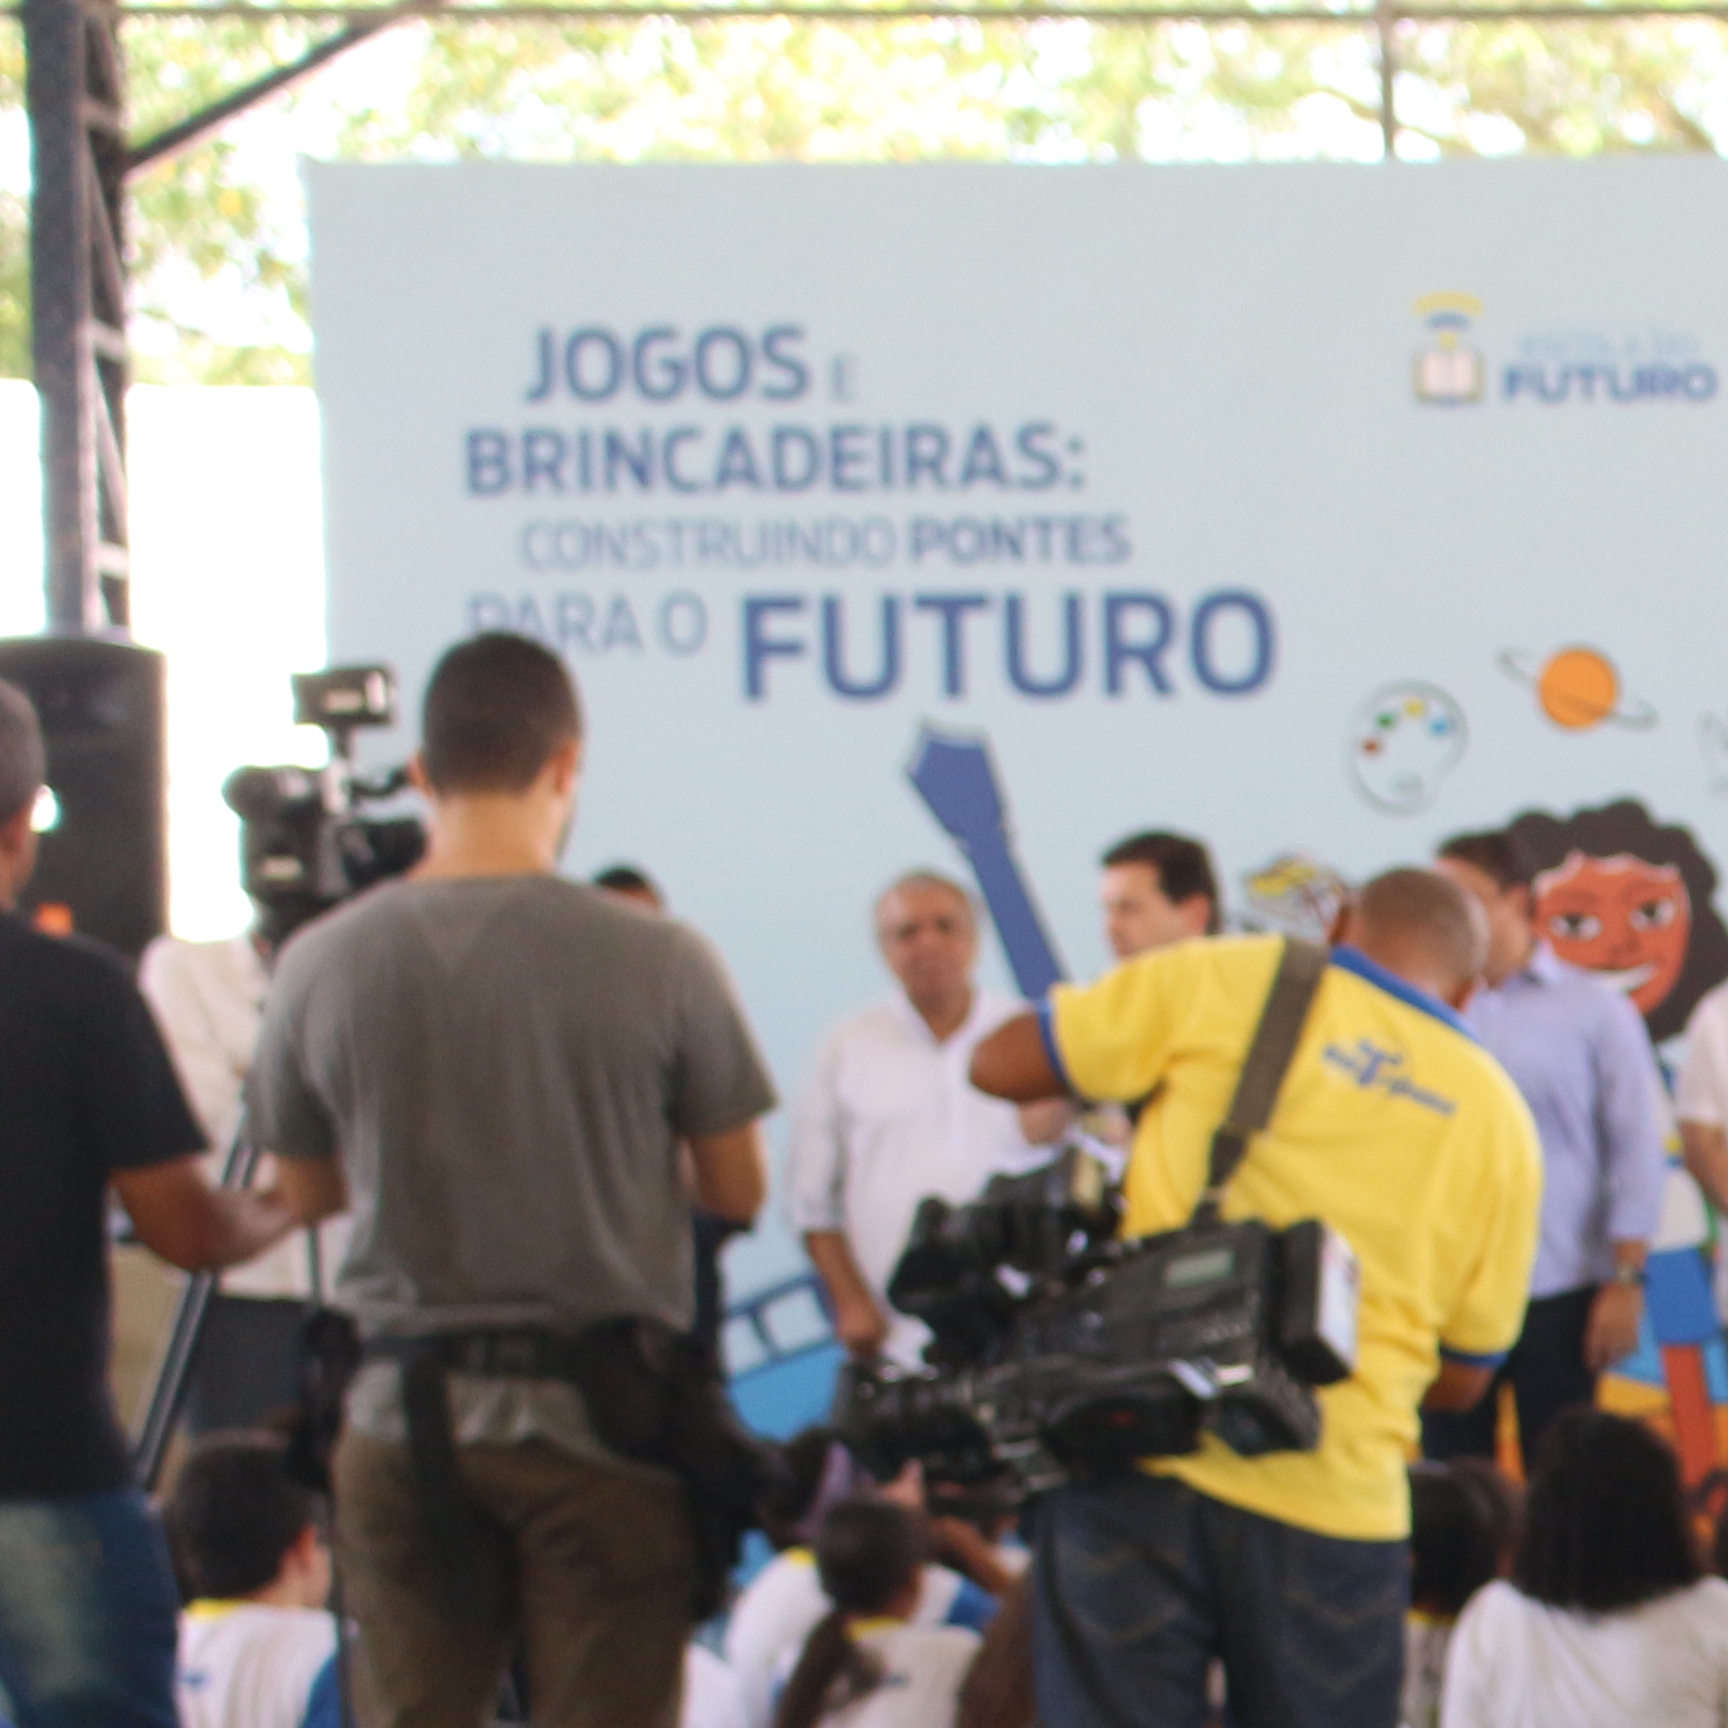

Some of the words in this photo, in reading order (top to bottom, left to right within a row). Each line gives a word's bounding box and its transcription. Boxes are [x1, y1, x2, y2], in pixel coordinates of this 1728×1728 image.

[526, 326, 812, 403] JOGOS
[830, 354, 858, 401] E
[1502, 362, 1718, 405] FUTURO
[466, 422, 1087, 494] BRINCADEIRAS:
[521, 515, 896, 572] CONSTRUINDO
[909, 512, 1134, 566] PONTES
[470, 590, 646, 655] PARA
[654, 588, 710, 658] O
[740, 590, 1276, 702] FUTURO
